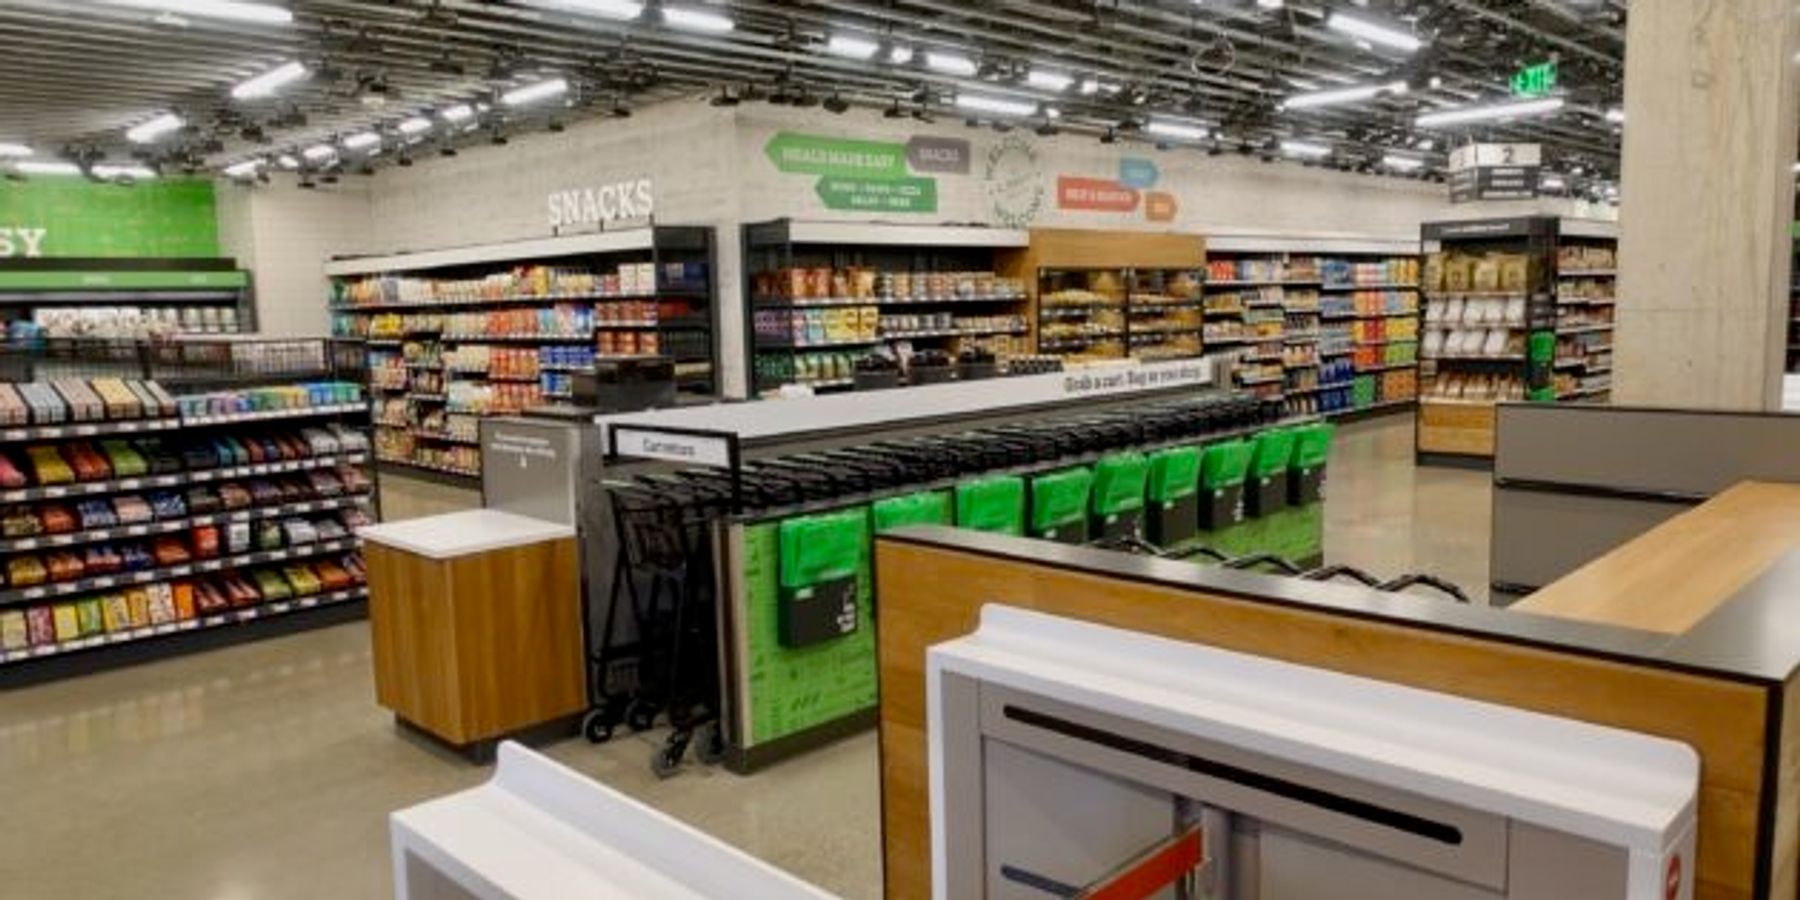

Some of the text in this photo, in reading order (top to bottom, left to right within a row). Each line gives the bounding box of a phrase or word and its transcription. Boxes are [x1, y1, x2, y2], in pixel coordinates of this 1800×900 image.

[1510, 64, 1557, 97] EXIT
[1502, 146, 1515, 165] 2
[548, 179, 653, 224] SNACKS
[1064, 375, 1093, 393] Grab
